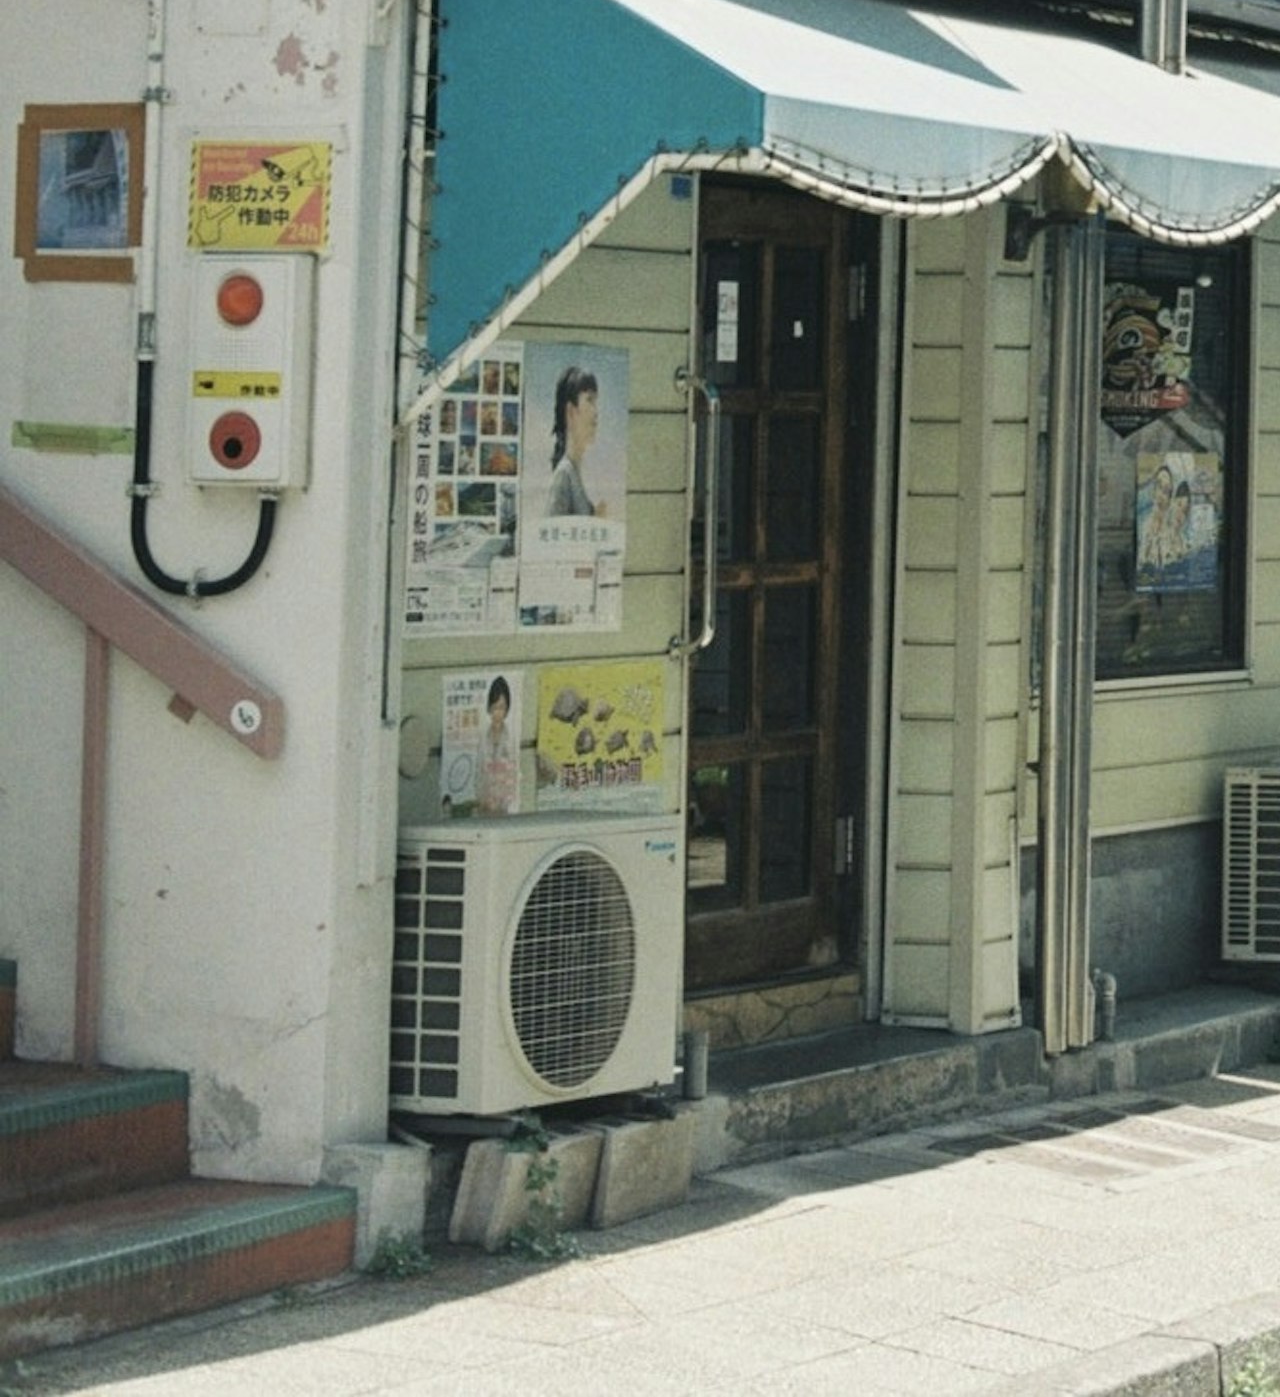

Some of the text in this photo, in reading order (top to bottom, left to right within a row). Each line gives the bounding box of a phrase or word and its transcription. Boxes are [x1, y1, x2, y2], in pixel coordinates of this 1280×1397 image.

[208, 185, 291, 202] 防犯カメラ
[238, 207, 290, 226] 作動中
